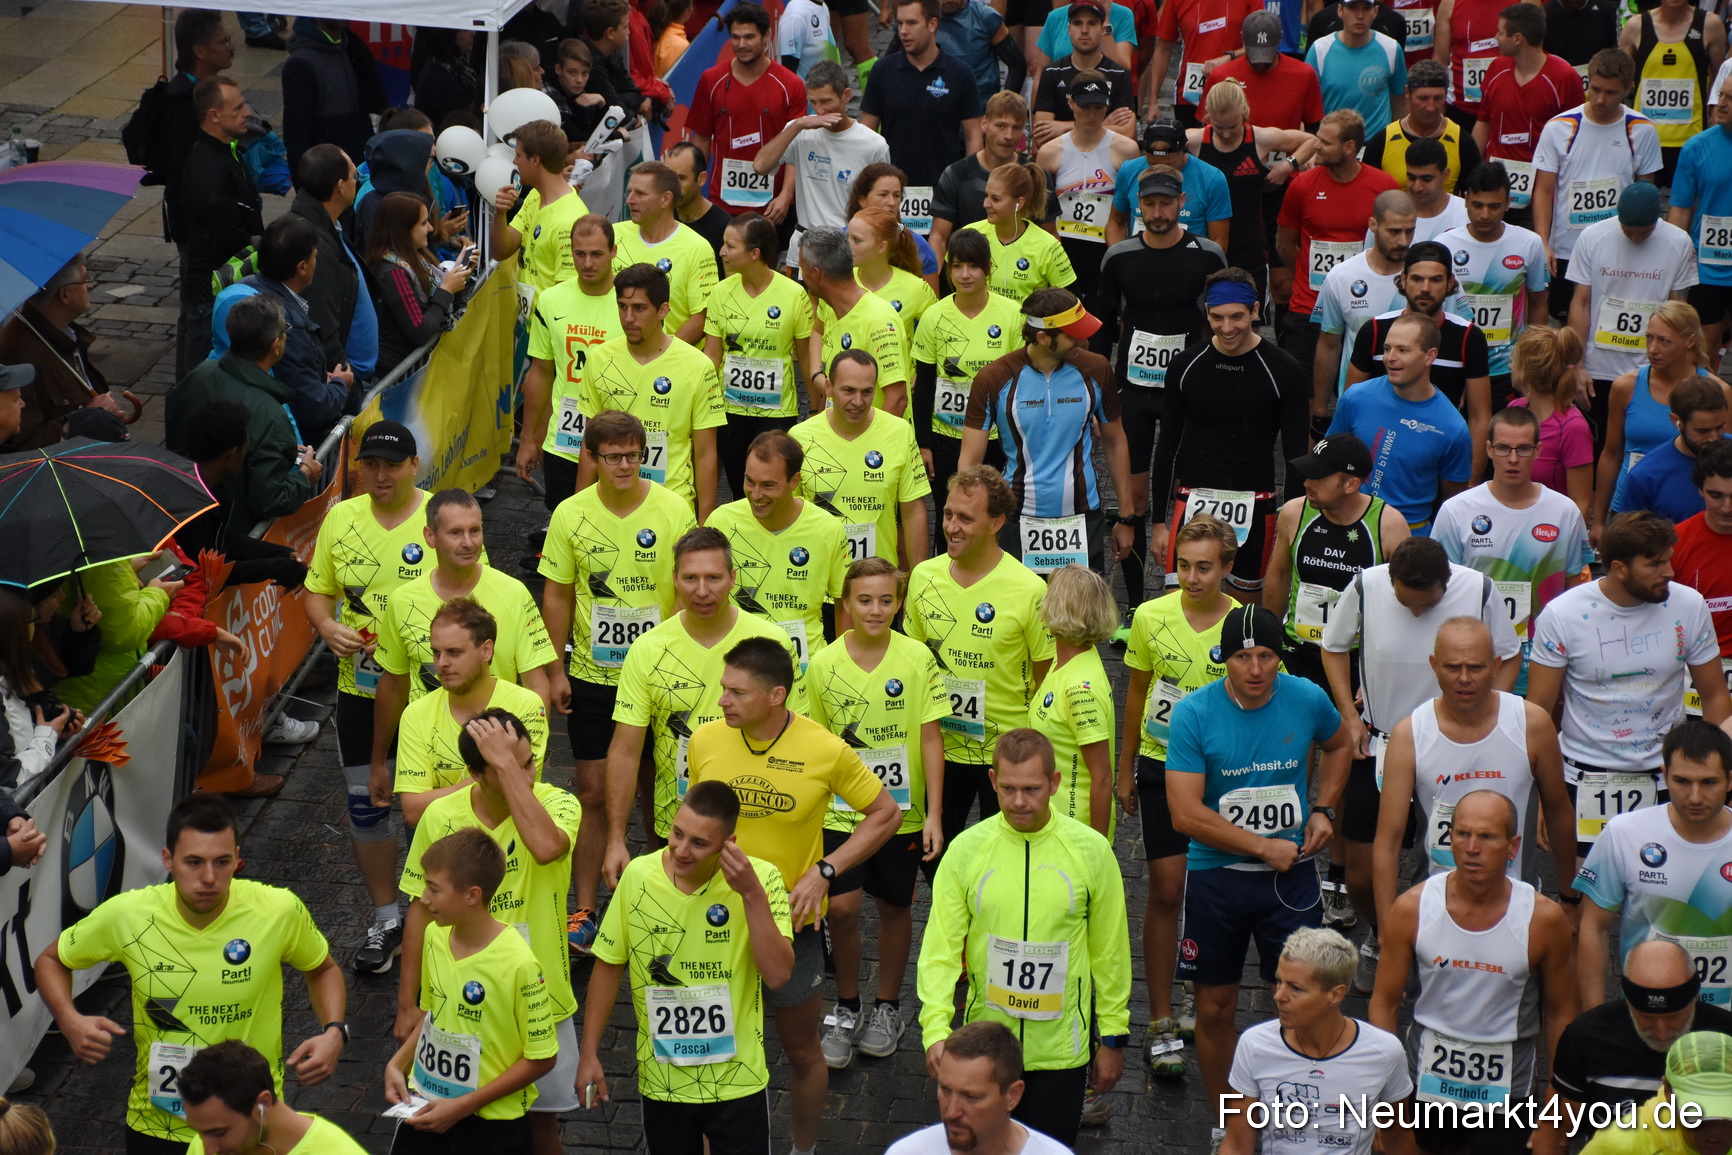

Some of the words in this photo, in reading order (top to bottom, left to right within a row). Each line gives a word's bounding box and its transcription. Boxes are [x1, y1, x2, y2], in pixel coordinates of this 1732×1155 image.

[1478, 41, 1494, 49] DEHN
[1646, 89, 1690, 108] 3096
[727, 170, 770, 190] 3024
[1573, 188, 1617, 211] 2862
[901, 199, 931, 217] 499
[1073, 202, 1096, 223] 82
[1578, 211, 1613, 223] Christoph
[1601, 266, 1664, 281] Kaiserwinkl
[764, 318, 781, 328] Partl
[1616, 312, 1643, 334] 63
[566, 323, 607, 338] Müller
[987, 339, 1002, 348] Partl
[1611, 335, 1640, 347] Roland
[965, 360, 977, 368] THE
[1215, 363, 1245, 372] uhlsport
[730, 367, 776, 391] 2861
[650, 395, 670, 406] Partl
[738, 392, 766, 404] Jessica
[562, 410, 584, 433] 24
[1381, 429, 1397, 457] SWIM
[863, 471, 885, 480] Partl
[1371, 468, 1384, 490] BIKE
[841, 496, 856, 504] THE
[857, 496, 877, 504] NEXT
[848, 503, 862, 511] 100
[863, 503, 885, 511] YEARS
[1193, 500, 1248, 525] 2790
[1027, 528, 1082, 552] 2684
[634, 550, 656, 560] Partl
[1323, 547, 1346, 559] DAV
[1034, 555, 1076, 567] Sebastian
[1302, 555, 1364, 574] Röthenbach
[398, 565, 422, 577] Partl
[786, 567, 809, 579] Partl
[616, 576, 630, 585] THE
[630, 576, 649, 584] NEXT
[622, 584, 635, 592] 100
[765, 593, 778, 602] THE
[778, 594, 799, 603] NEXT
[771, 601, 785, 610] 100
[786, 600, 808, 610] YEARS
[971, 623, 993, 636] Partl
[1595, 624, 1662, 661] Herr
[948, 648, 962, 658] THE
[963, 651, 983, 661] NEXT
[954, 658, 967, 667] 100
[968, 660, 995, 669] YEARS
[884, 698, 905, 709] Partl
[951, 693, 979, 719] 24
[1155, 699, 1172, 724] 2
[864, 727, 879, 735] THE
[879, 724, 898, 734] NEXT
[873, 734, 886, 742] 100
[886, 731, 908, 741] YEARS
[408, 768, 426, 777] Partl
[1221, 758, 1299, 777] www.hasit.de
[873, 762, 903, 787] 23
[1454, 770, 1507, 782] KLEBL
[730, 776, 774, 793] PIZZERIA
[1593, 789, 1643, 816] 112
[1228, 802, 1296, 831] 2490
[405, 868, 423, 881] Partl
[1638, 869, 1668, 881] PARTL
[1639, 878, 1668, 886] Neumarkt
[499, 899, 524, 910] YEARS
[705, 929, 731, 940] Partl
[1023, 944, 1062, 955] BOCK
[679, 961, 698, 970] THE
[699, 961, 723, 970] NEXT
[1452, 959, 1508, 975] KLEBL
[221, 966, 252, 980] Partl
[689, 970, 706, 980] 100
[706, 970, 732, 980] YEARS
[1002, 959, 1054, 990] 187
[221, 976, 252, 985] Neumarkt
[1008, 995, 1040, 1010] David
[187, 1004, 210, 1016] THE
[211, 1003, 240, 1015] NEXT
[458, 1003, 483, 1018] Partl
[198, 1014, 217, 1025] 100
[219, 1008, 253, 1024] YEARS
[655, 1004, 726, 1036] 2826
[673, 1042, 710, 1055] Pascal
[418, 1033, 471, 1083] 2866
[1430, 1044, 1505, 1082] 2535
[158, 1065, 177, 1094] 2
[422, 1076, 450, 1096] Jonas
[1440, 1081, 1489, 1101] Berthold
